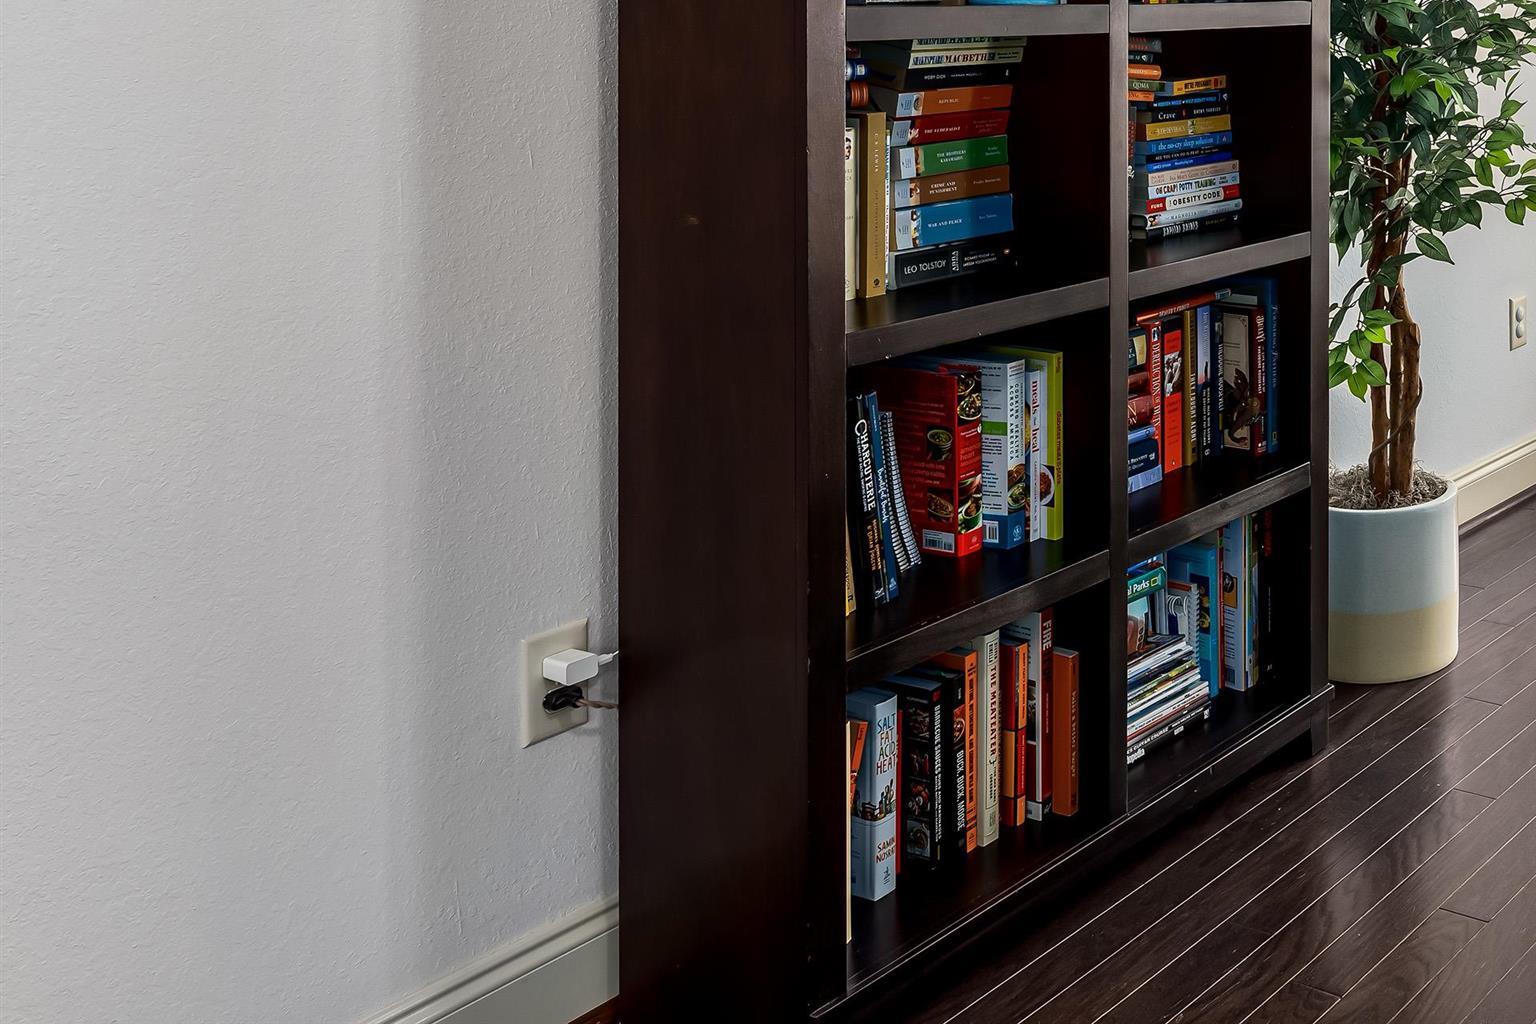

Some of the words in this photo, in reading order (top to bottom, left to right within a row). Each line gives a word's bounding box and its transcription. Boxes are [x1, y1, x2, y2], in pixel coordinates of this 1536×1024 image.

[945, 53, 988, 65] MACBETH
[1158, 143, 1167, 151] the
[1179, 182, 1194, 191] POTTY
[1194, 178, 1216, 189] TRAINING
[1172, 195, 1201, 206] OBESITY
[1202, 191, 1221, 200] CODE
[903, 265, 917, 275] LEO
[919, 259, 948, 271] TOLSTOY
[1151, 343, 1161, 396] DERELICTION
[1031, 380, 1040, 415] meals
[1031, 427, 1040, 453] heal
[854, 419, 876, 511] CHARCUTERIE
[1132, 579, 1150, 594] Parks
[1042, 619, 1052, 651] FIRE
[877, 713, 896, 733] SALT
[933, 704, 942, 744] BARBECUE
[989, 690, 998, 758] MEATEATER
[879, 729, 896, 746] FAT
[878, 741, 897, 761] ACID
[934, 744, 942, 773] SAUCES
[876, 756, 898, 775] HEAT
[957, 802, 966, 832] MOOSE
